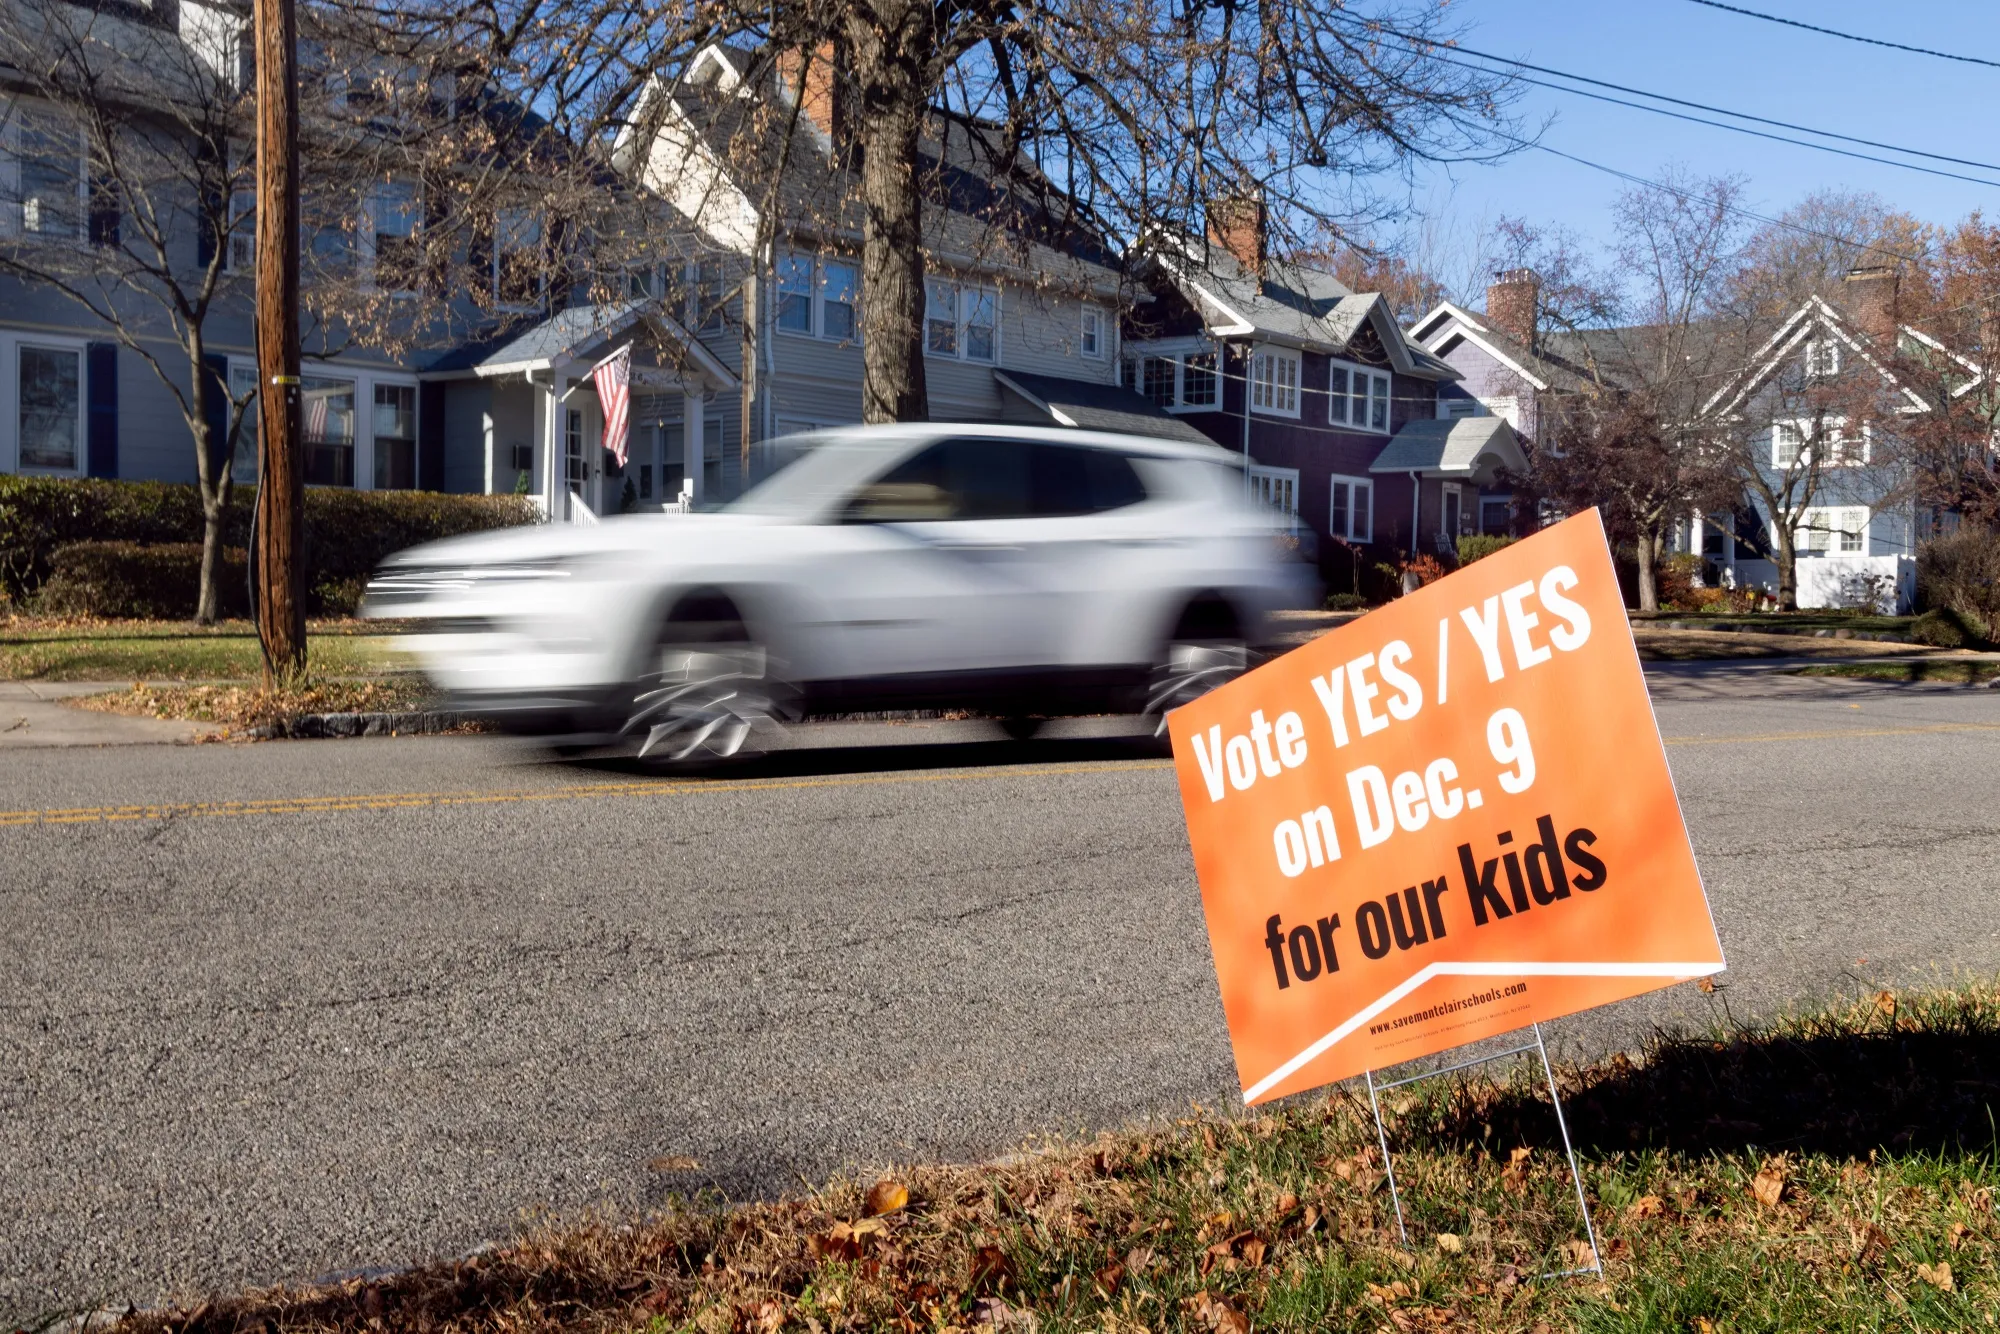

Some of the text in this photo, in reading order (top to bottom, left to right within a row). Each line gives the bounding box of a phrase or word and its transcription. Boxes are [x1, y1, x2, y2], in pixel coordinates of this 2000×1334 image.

[1191, 565, 1591, 802] Vote YES / YES
[1274, 708, 1535, 877] on Dec. 9
[1265, 815, 1606, 989] for our kids
[1369, 982, 1527, 1035] www.savemontclairschools.com
